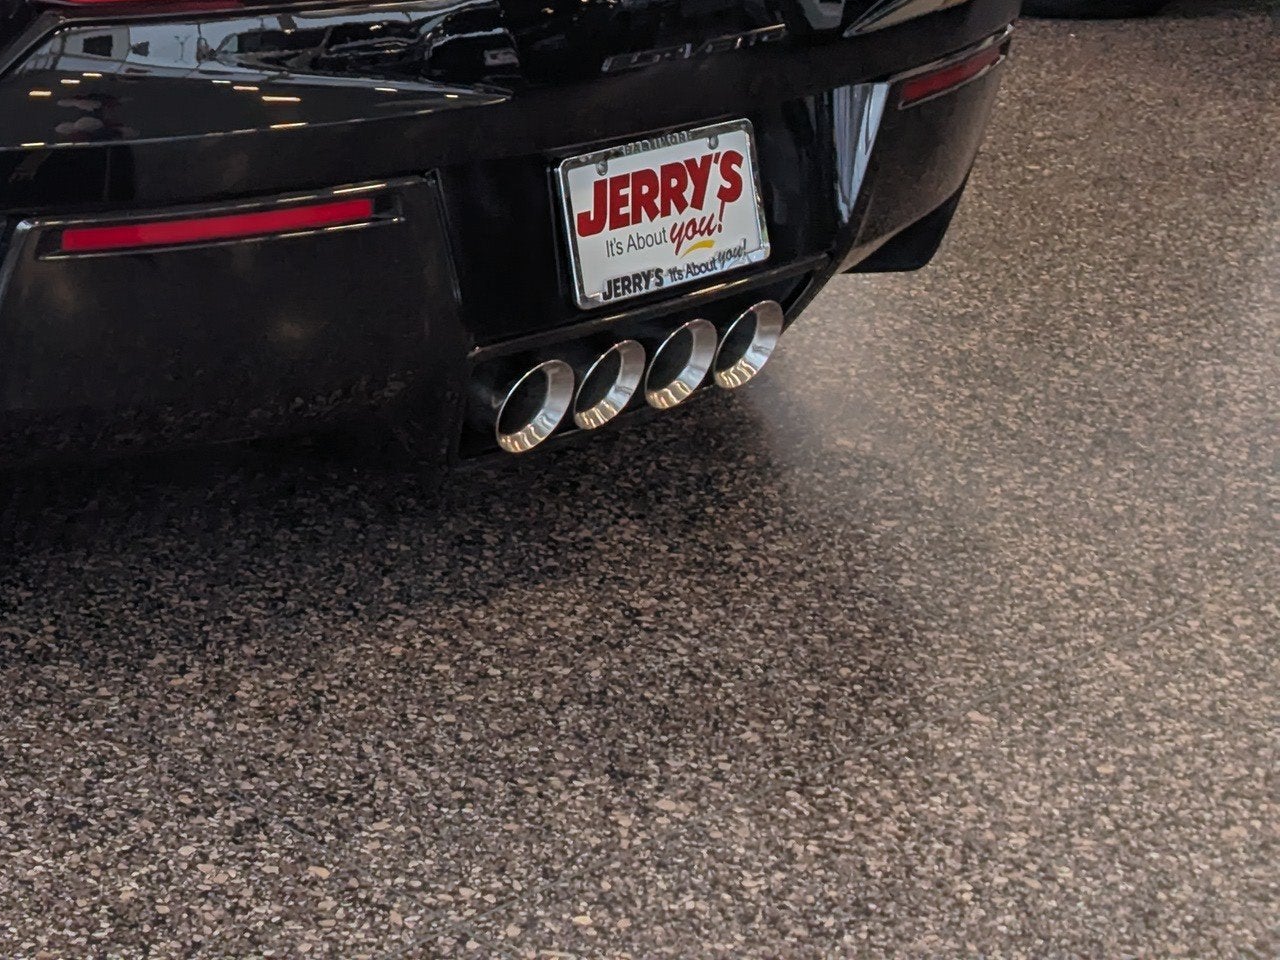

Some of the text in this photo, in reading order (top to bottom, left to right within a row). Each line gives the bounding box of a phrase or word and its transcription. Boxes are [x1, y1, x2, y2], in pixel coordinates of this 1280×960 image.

[577, 150, 744, 237] JERRY'S
[606, 200, 726, 258] It's About you!
[602, 238, 748, 301] JERRY'S It's About you!
